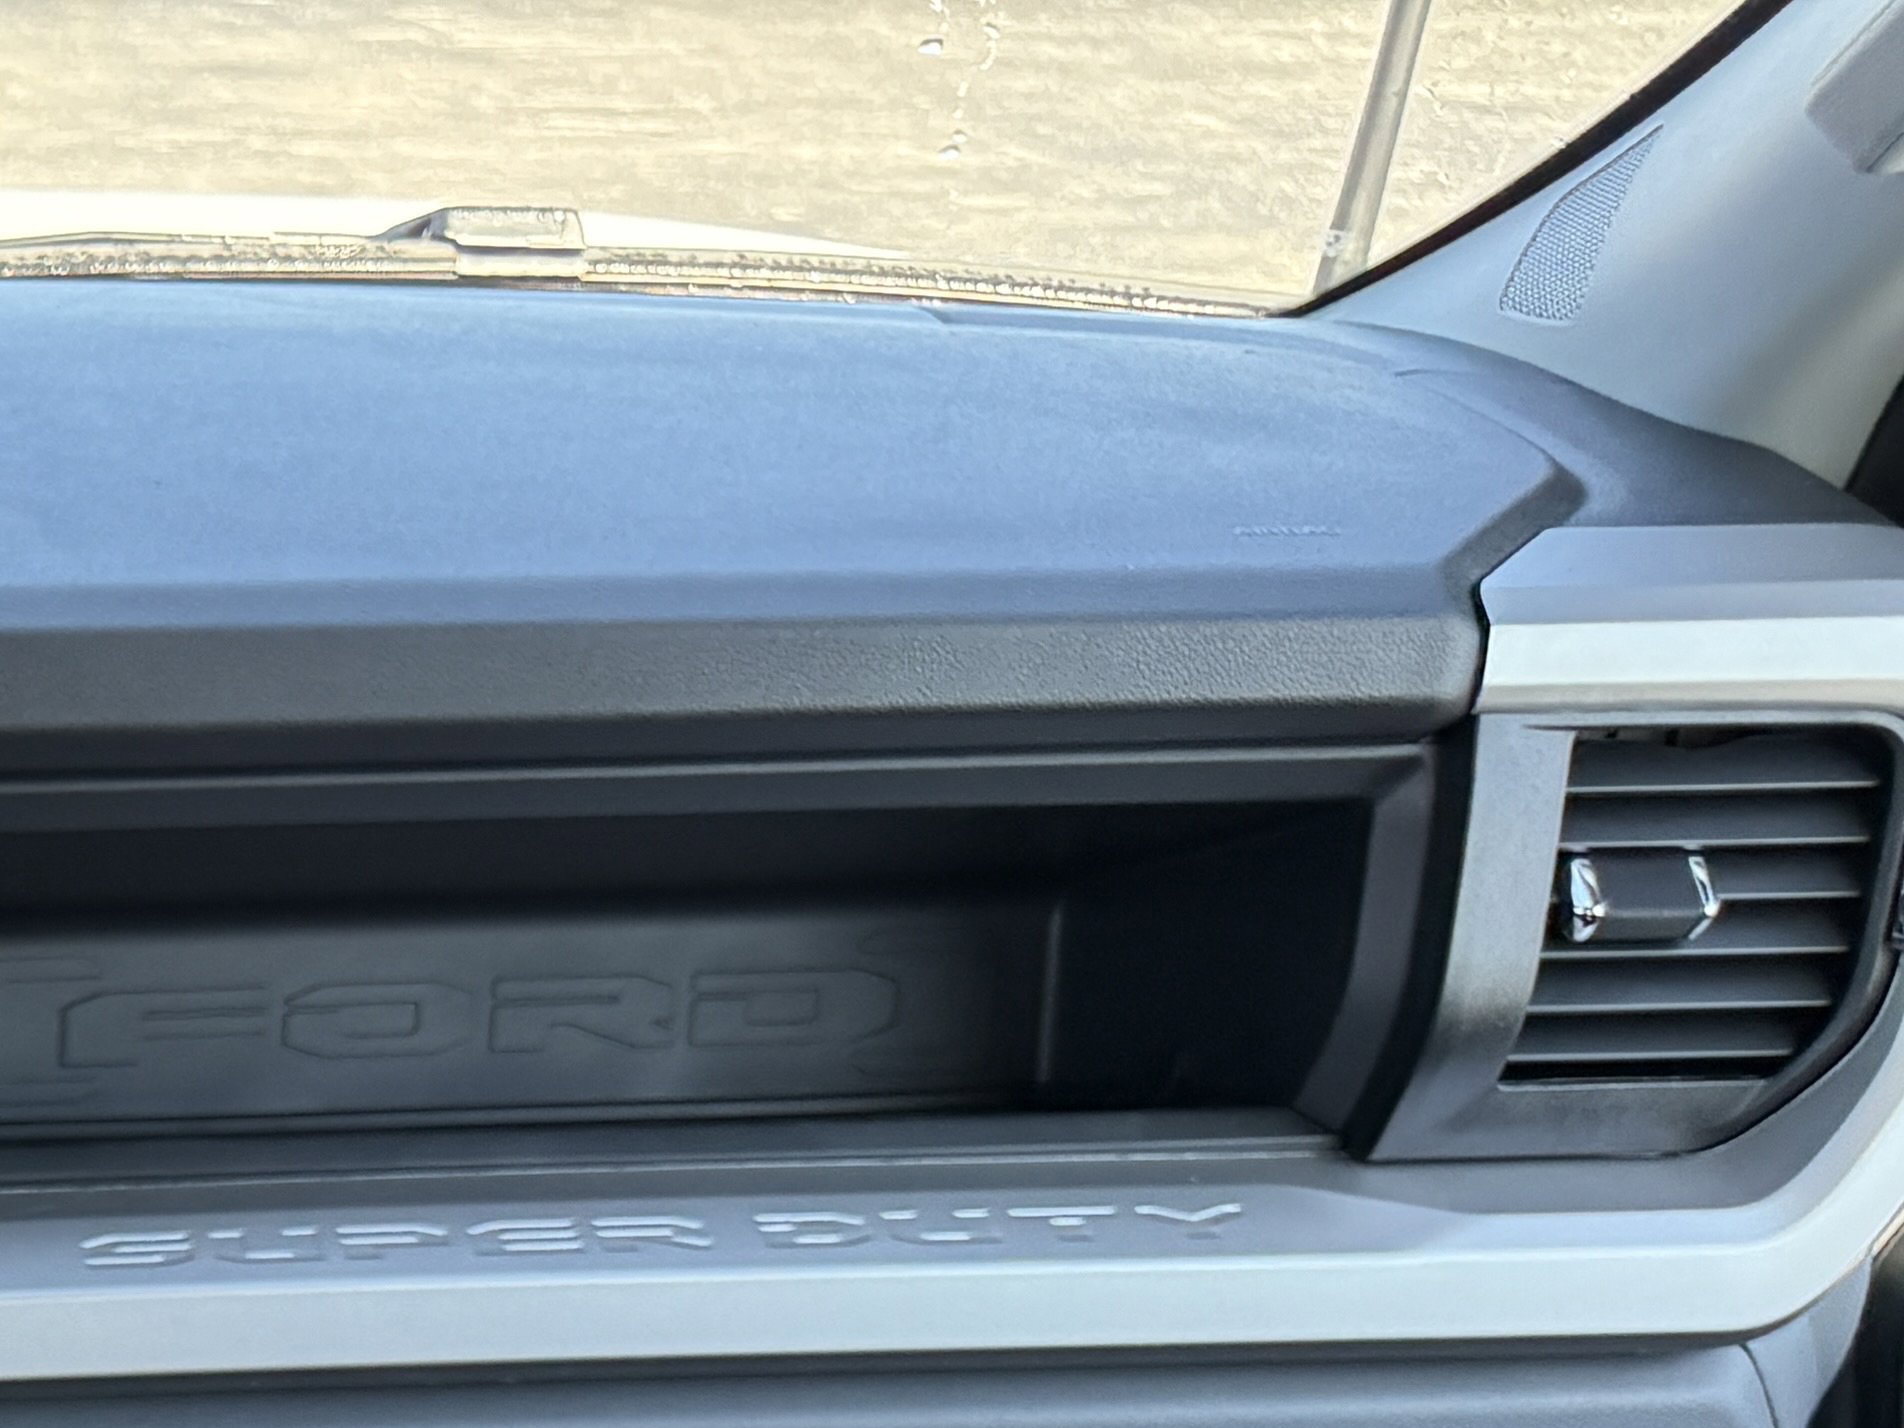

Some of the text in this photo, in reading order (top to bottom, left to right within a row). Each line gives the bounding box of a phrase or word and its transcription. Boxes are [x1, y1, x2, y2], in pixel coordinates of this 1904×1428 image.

[58, 967, 898, 1069] FORD
[79, 1202, 1243, 1268] SUPER DUTY
